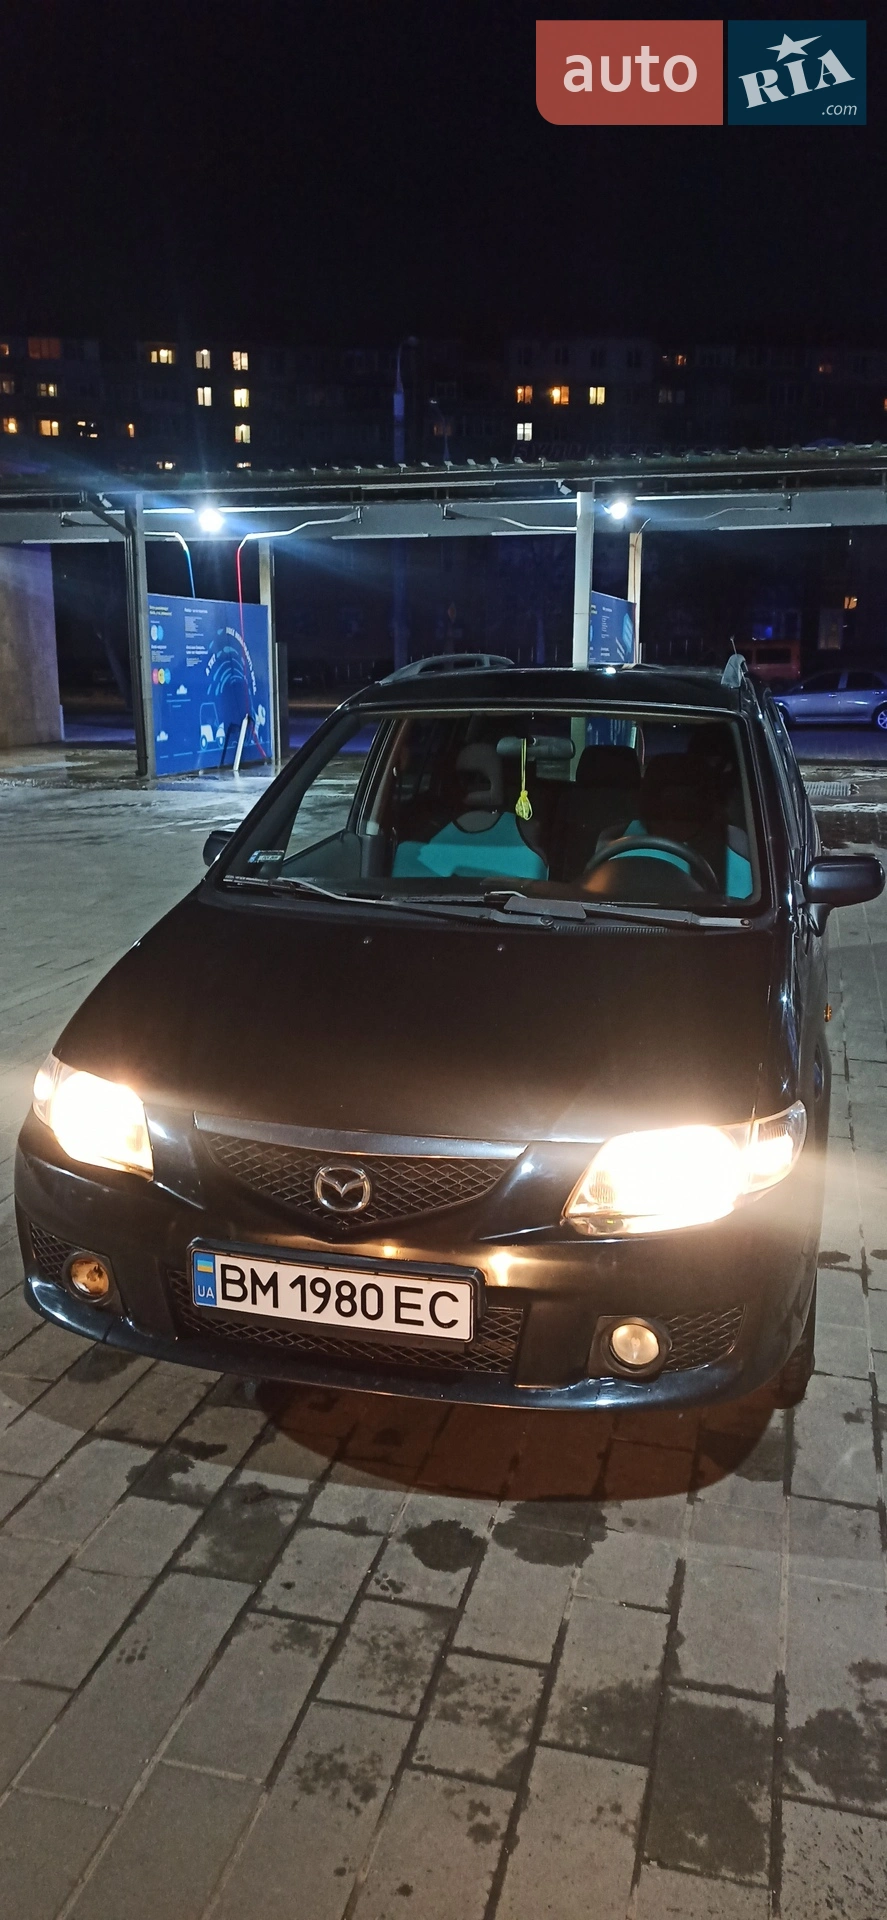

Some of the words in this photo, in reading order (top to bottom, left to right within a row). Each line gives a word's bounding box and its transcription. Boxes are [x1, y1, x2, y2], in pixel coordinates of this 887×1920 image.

[197, 1285, 215, 1299] UA
[220, 1263, 279, 1308] BM
[289, 1274, 384, 1321] 1980
[394, 1285, 459, 1329] EC
